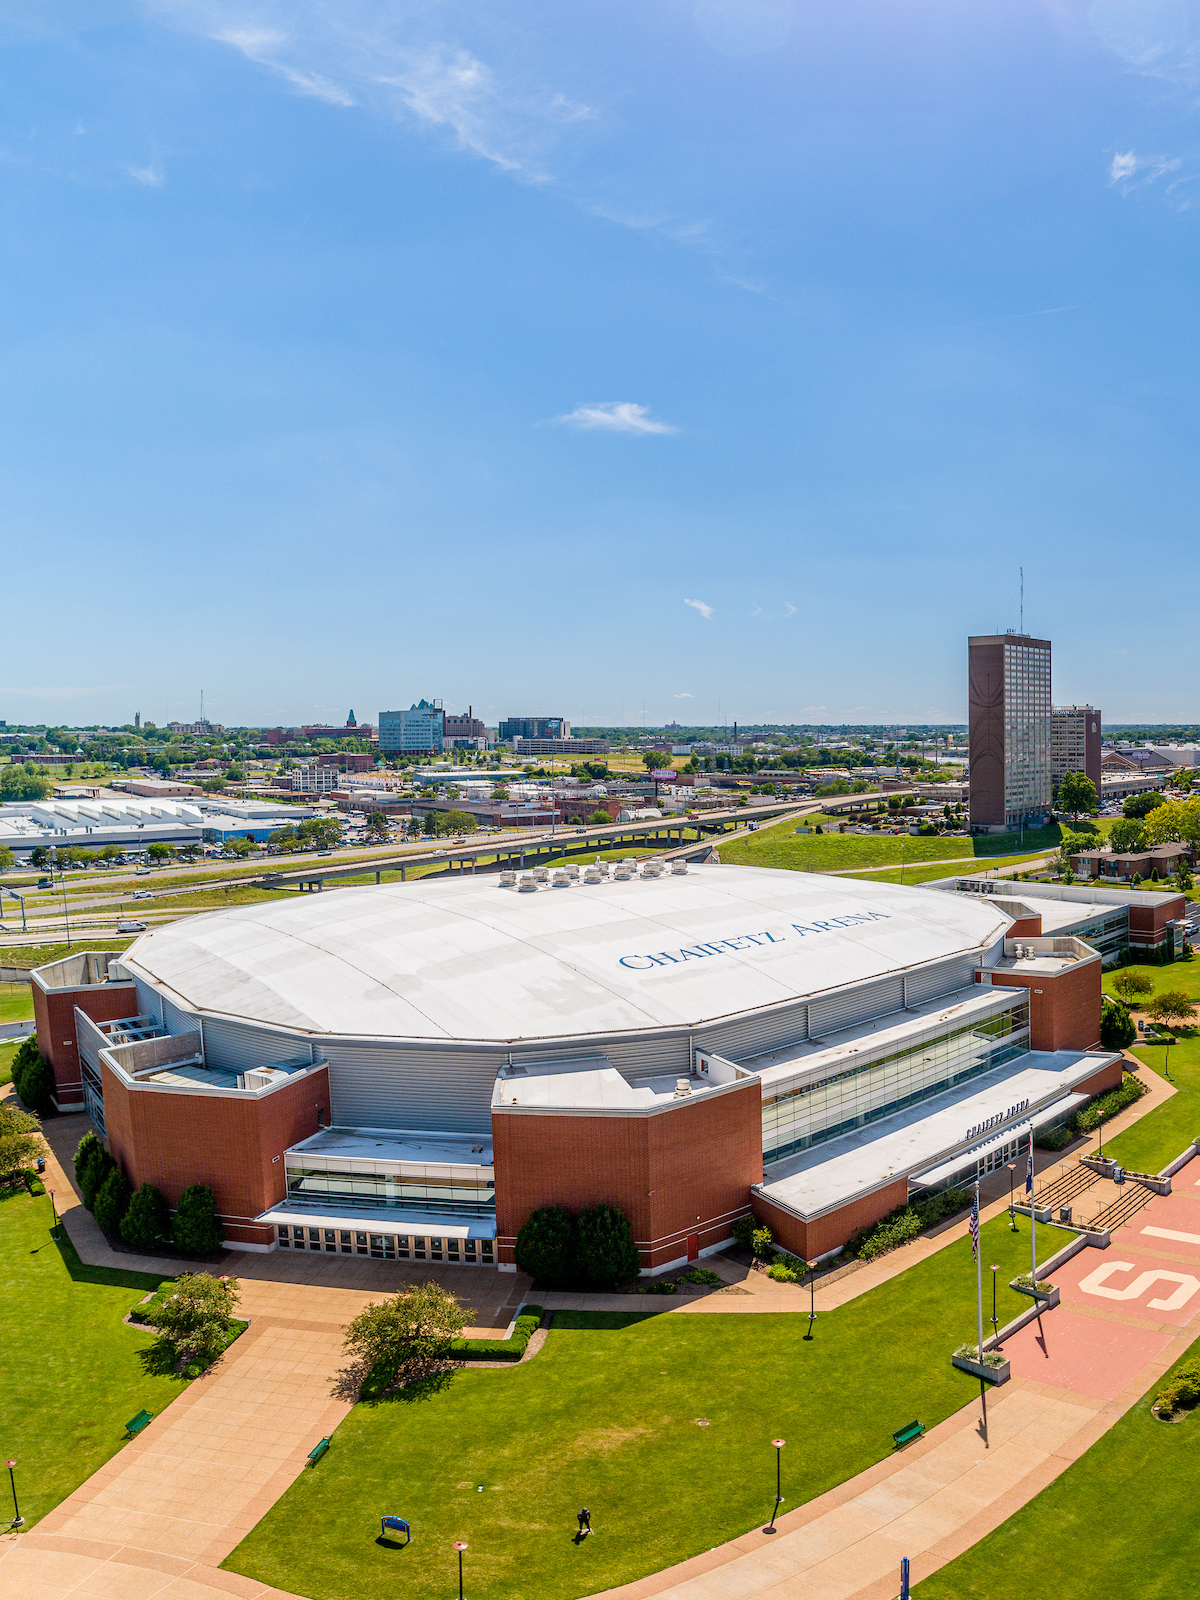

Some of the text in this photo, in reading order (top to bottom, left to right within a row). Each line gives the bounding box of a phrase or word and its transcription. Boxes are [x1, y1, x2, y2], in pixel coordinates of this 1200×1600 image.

[618, 910, 892, 970] CHAIFETZ ARENA
[966, 1098, 1030, 1139] CHAIFETZ ARENA
